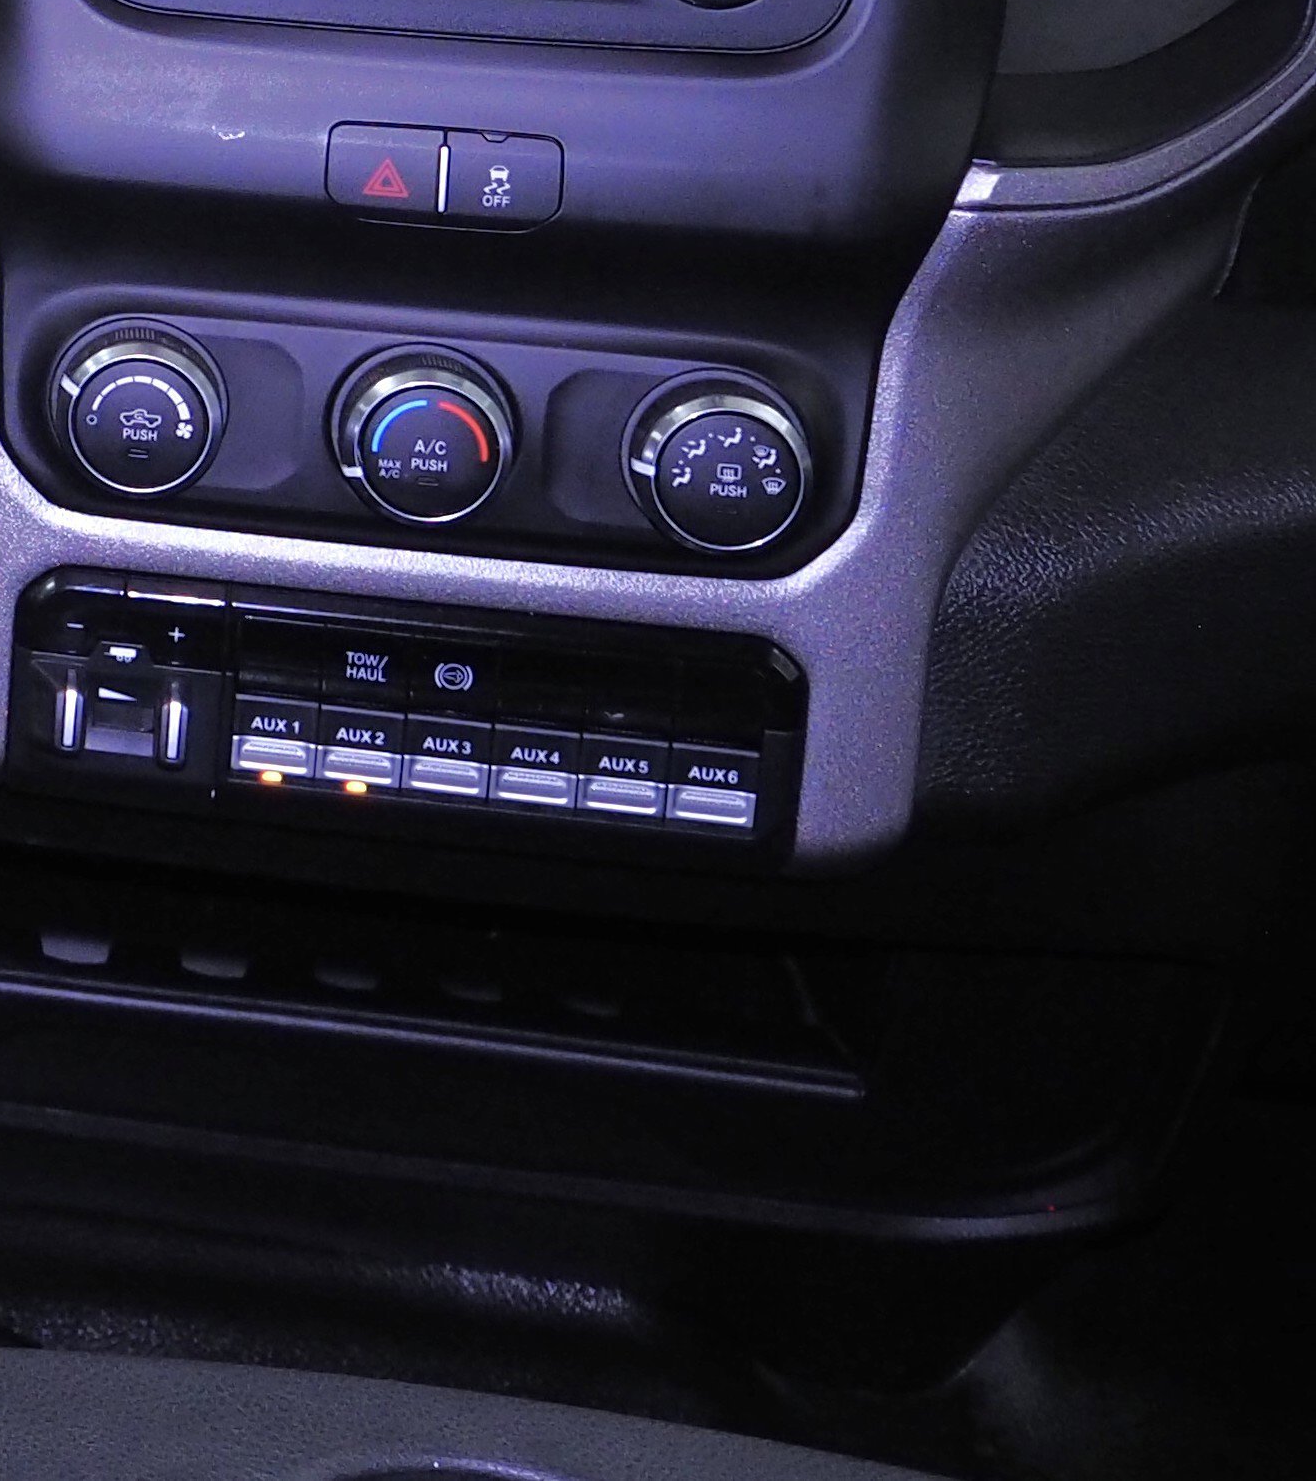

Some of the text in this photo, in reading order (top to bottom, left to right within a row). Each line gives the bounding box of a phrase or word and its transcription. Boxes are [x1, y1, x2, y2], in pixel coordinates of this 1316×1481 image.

[482, 194, 511, 208] OFF
[122, 427, 158, 443] PUSH
[414, 437, 448, 456] A/C
[377, 458, 402, 471] MAX
[378, 468, 401, 480] A/C
[410, 457, 449, 474] PUSH
[709, 483, 748, 499] PUSH
[345, 650, 389, 669] TOW/
[345, 665, 388, 684] HAUL
[250, 715, 301, 735] AUX 1
[335, 726, 386, 747] AUX 2
[423, 735, 472, 756] AUX 3
[511, 746, 561, 765] AUX 4
[598, 755, 649, 775] AUX 5
[688, 764, 739, 785] AUX 6
